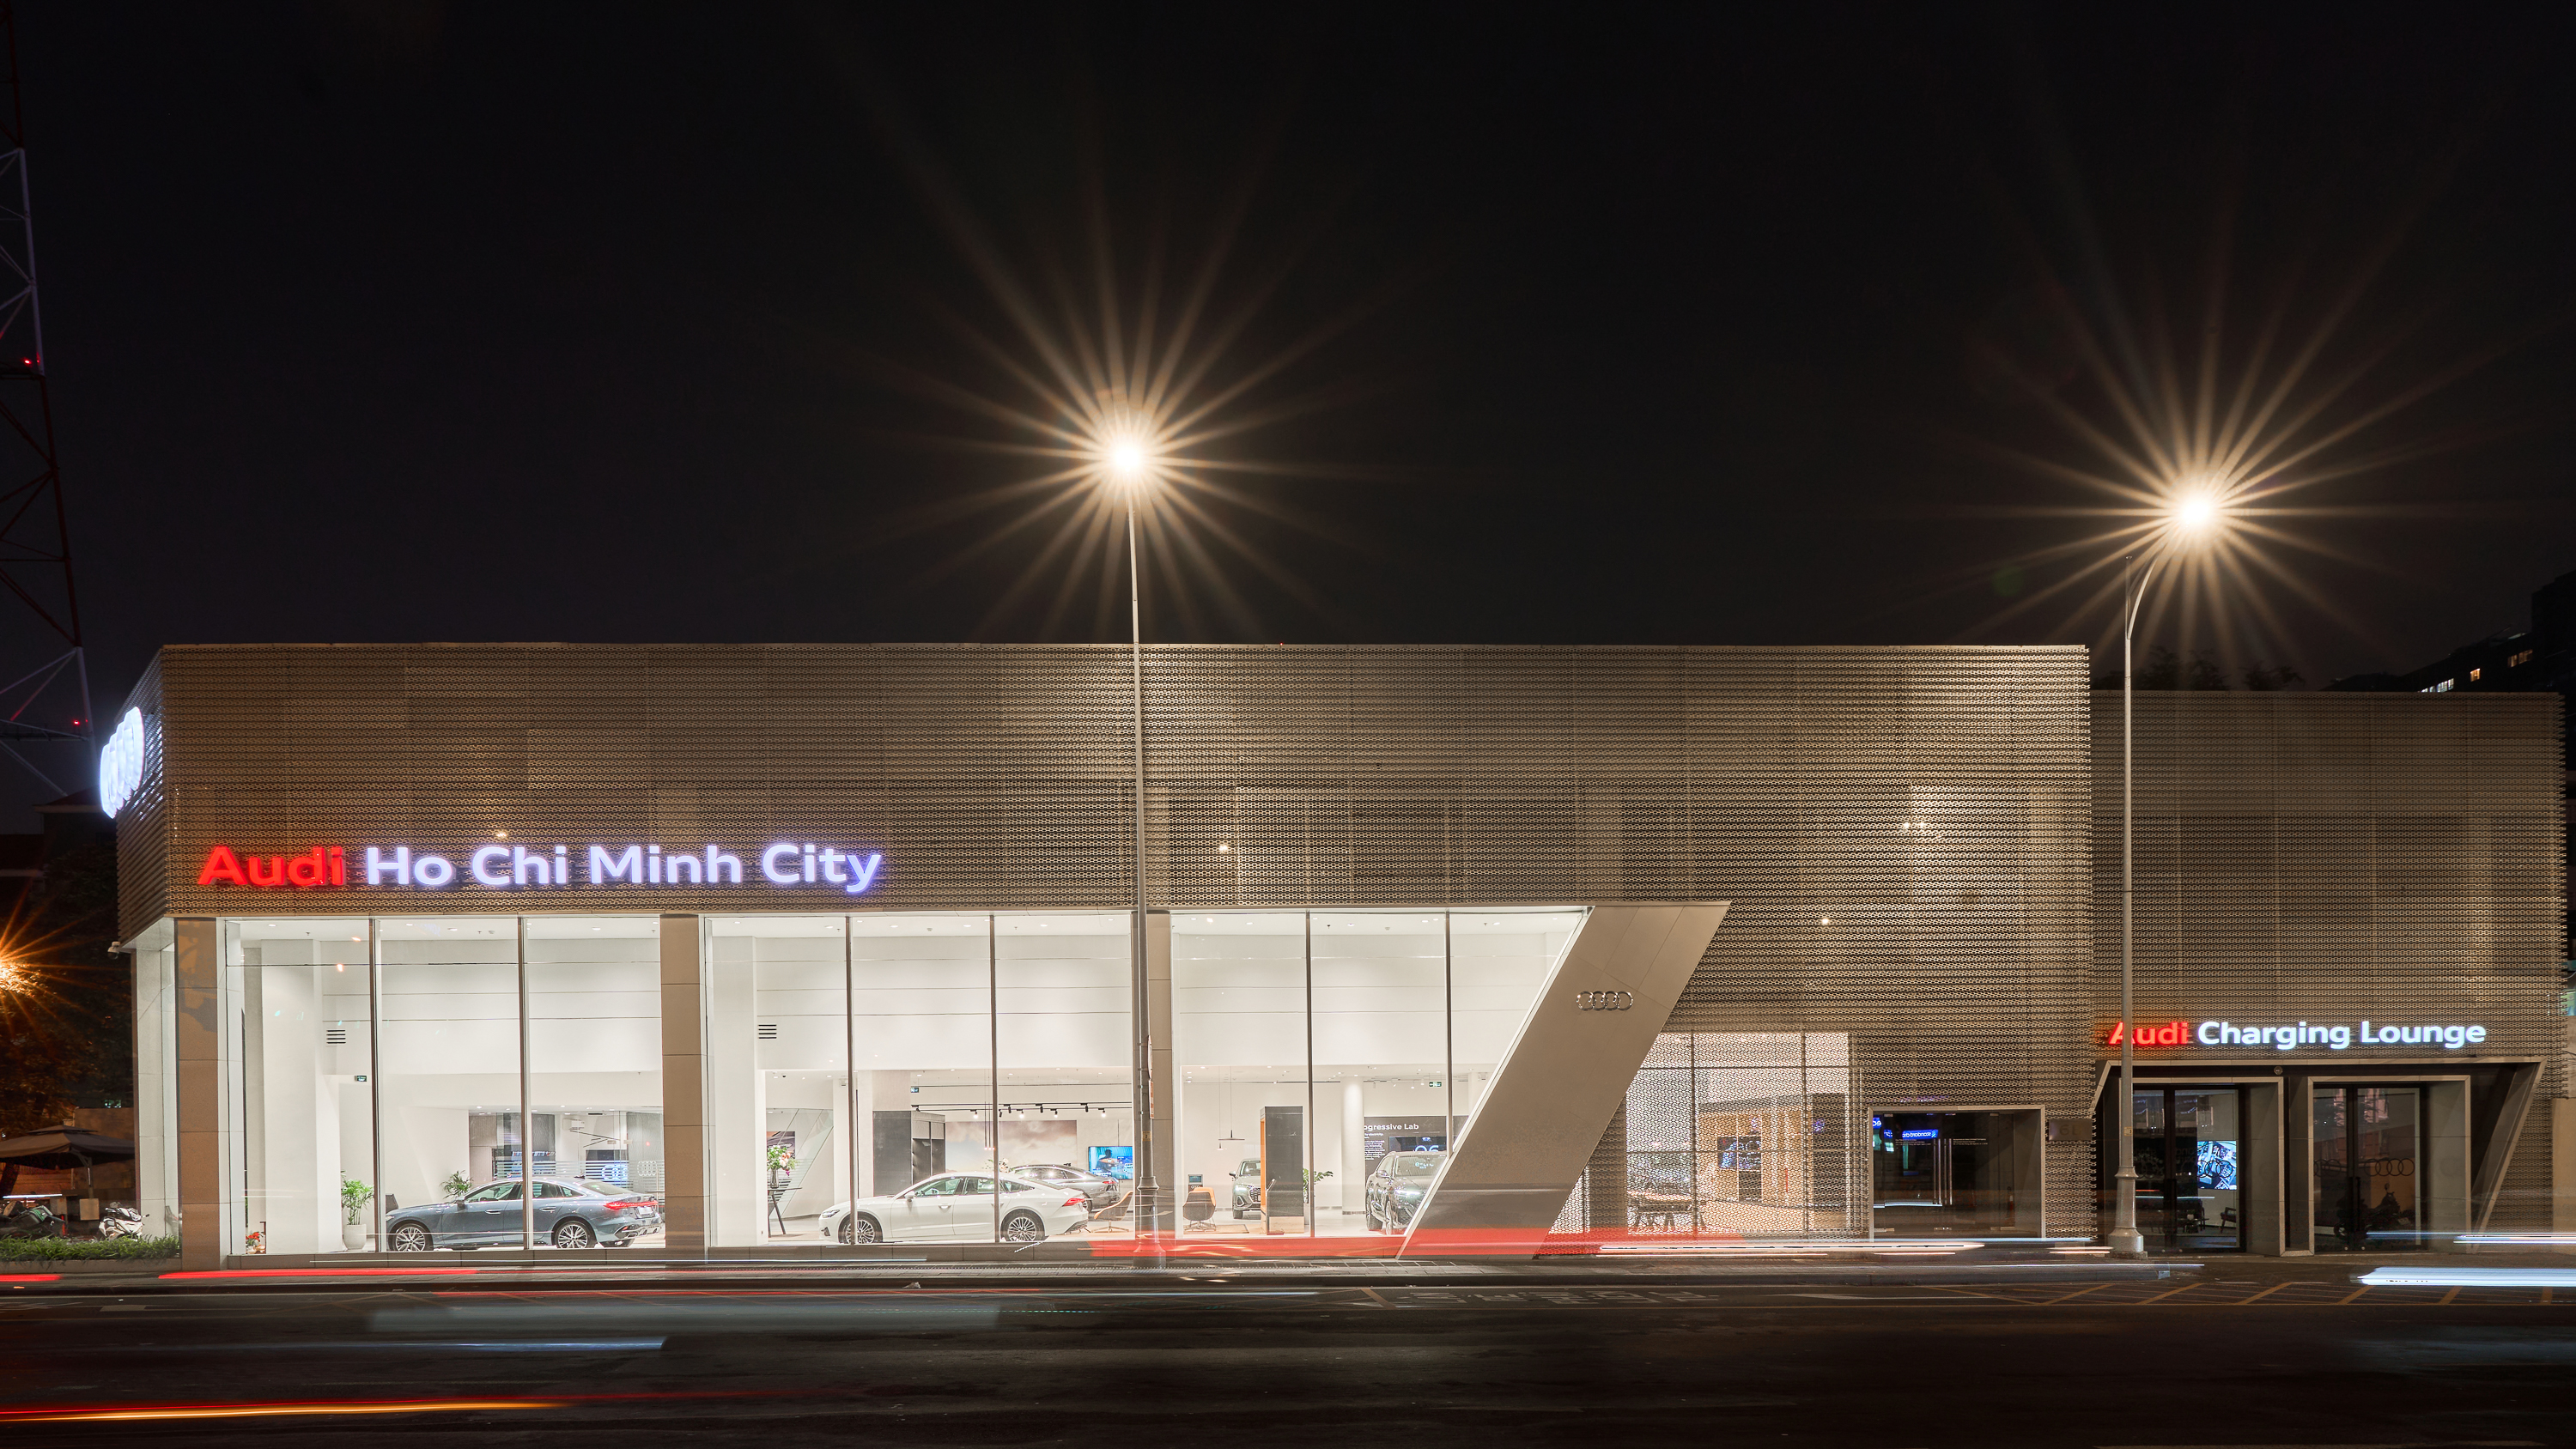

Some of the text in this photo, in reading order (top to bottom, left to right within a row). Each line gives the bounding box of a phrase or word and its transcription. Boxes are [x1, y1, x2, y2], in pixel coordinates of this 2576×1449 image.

[197, 844, 882, 893] Audi Ho Chi Minh City
[2197, 1021, 2350, 1050] Charging
[2360, 1021, 2486, 1049] Lounge
